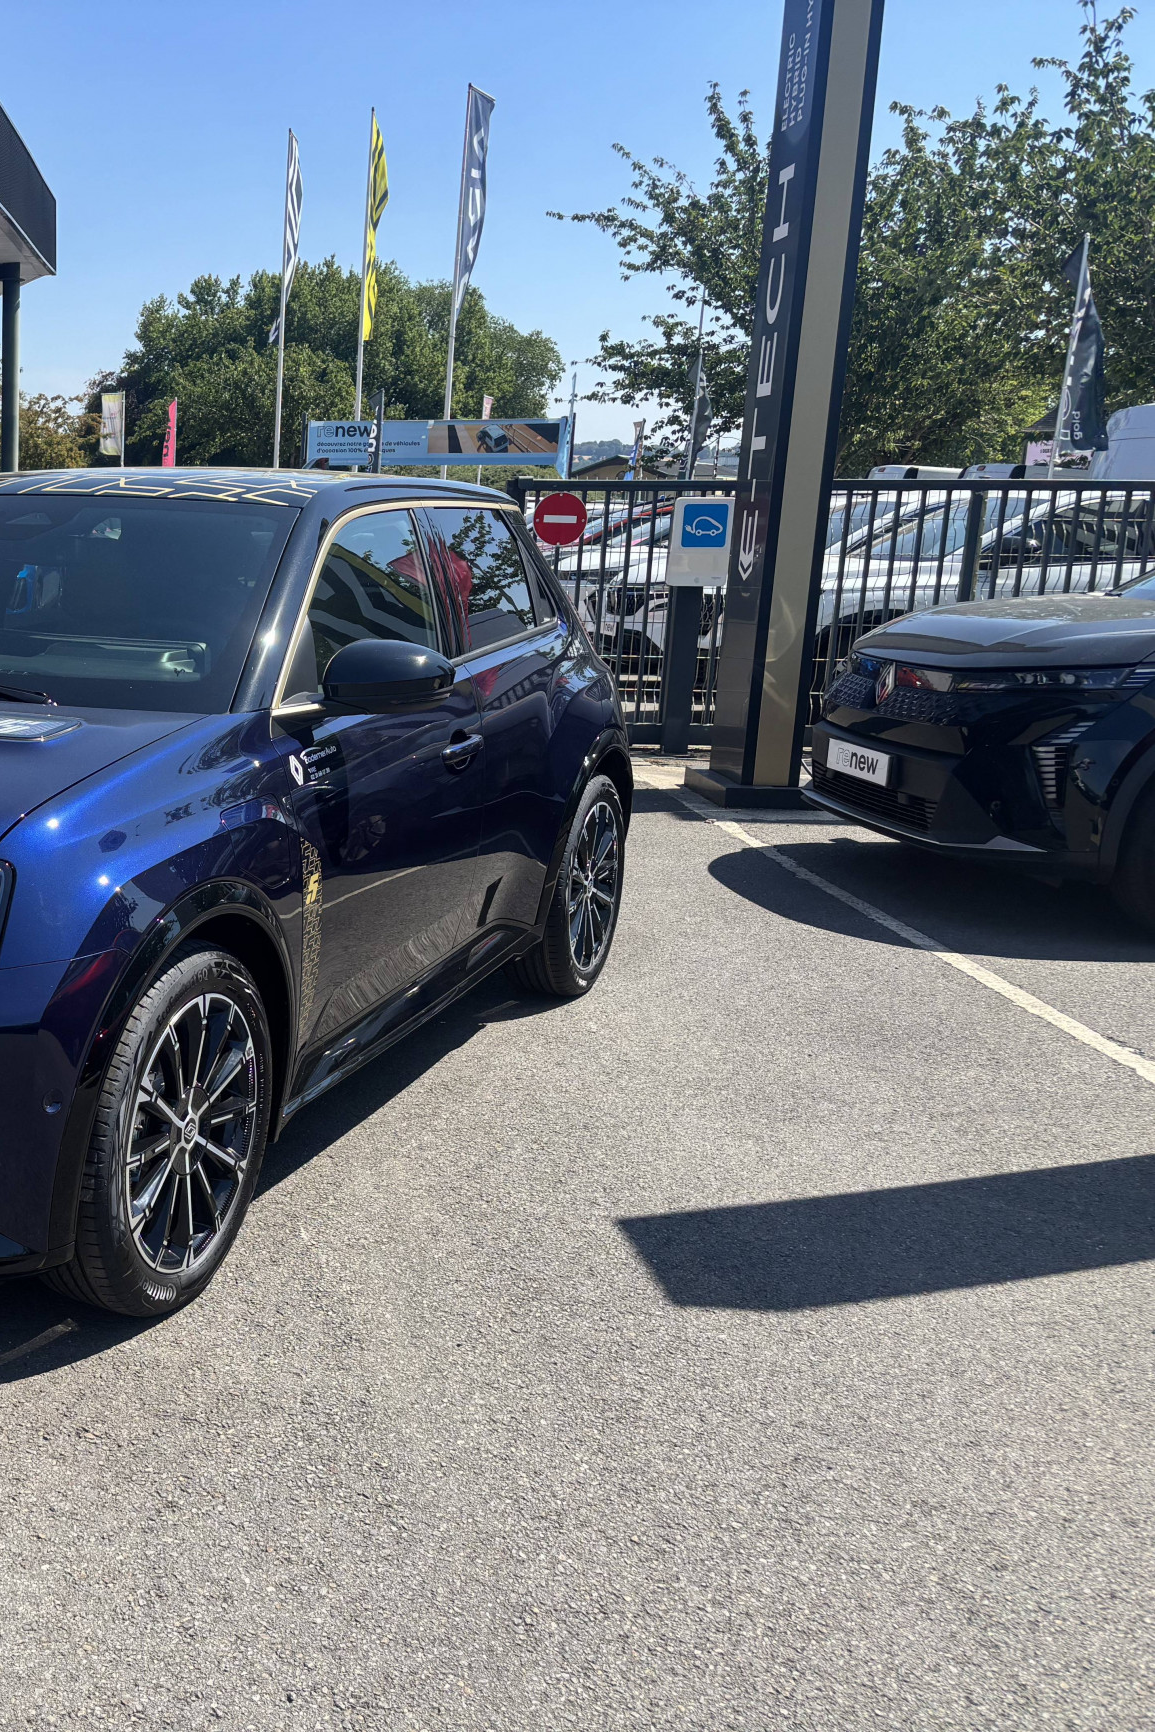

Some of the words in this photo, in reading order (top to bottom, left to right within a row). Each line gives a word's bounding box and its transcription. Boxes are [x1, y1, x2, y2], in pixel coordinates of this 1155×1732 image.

[781, 32, 796, 132] ELECTRIC
[789, 47, 802, 127] HYBRID
[797, 32, 811, 122] PLUG-IN
[317, 440, 346, 448] découvrez
[1071, 410, 1083, 440] gold
[835, 746, 879, 775] renew
